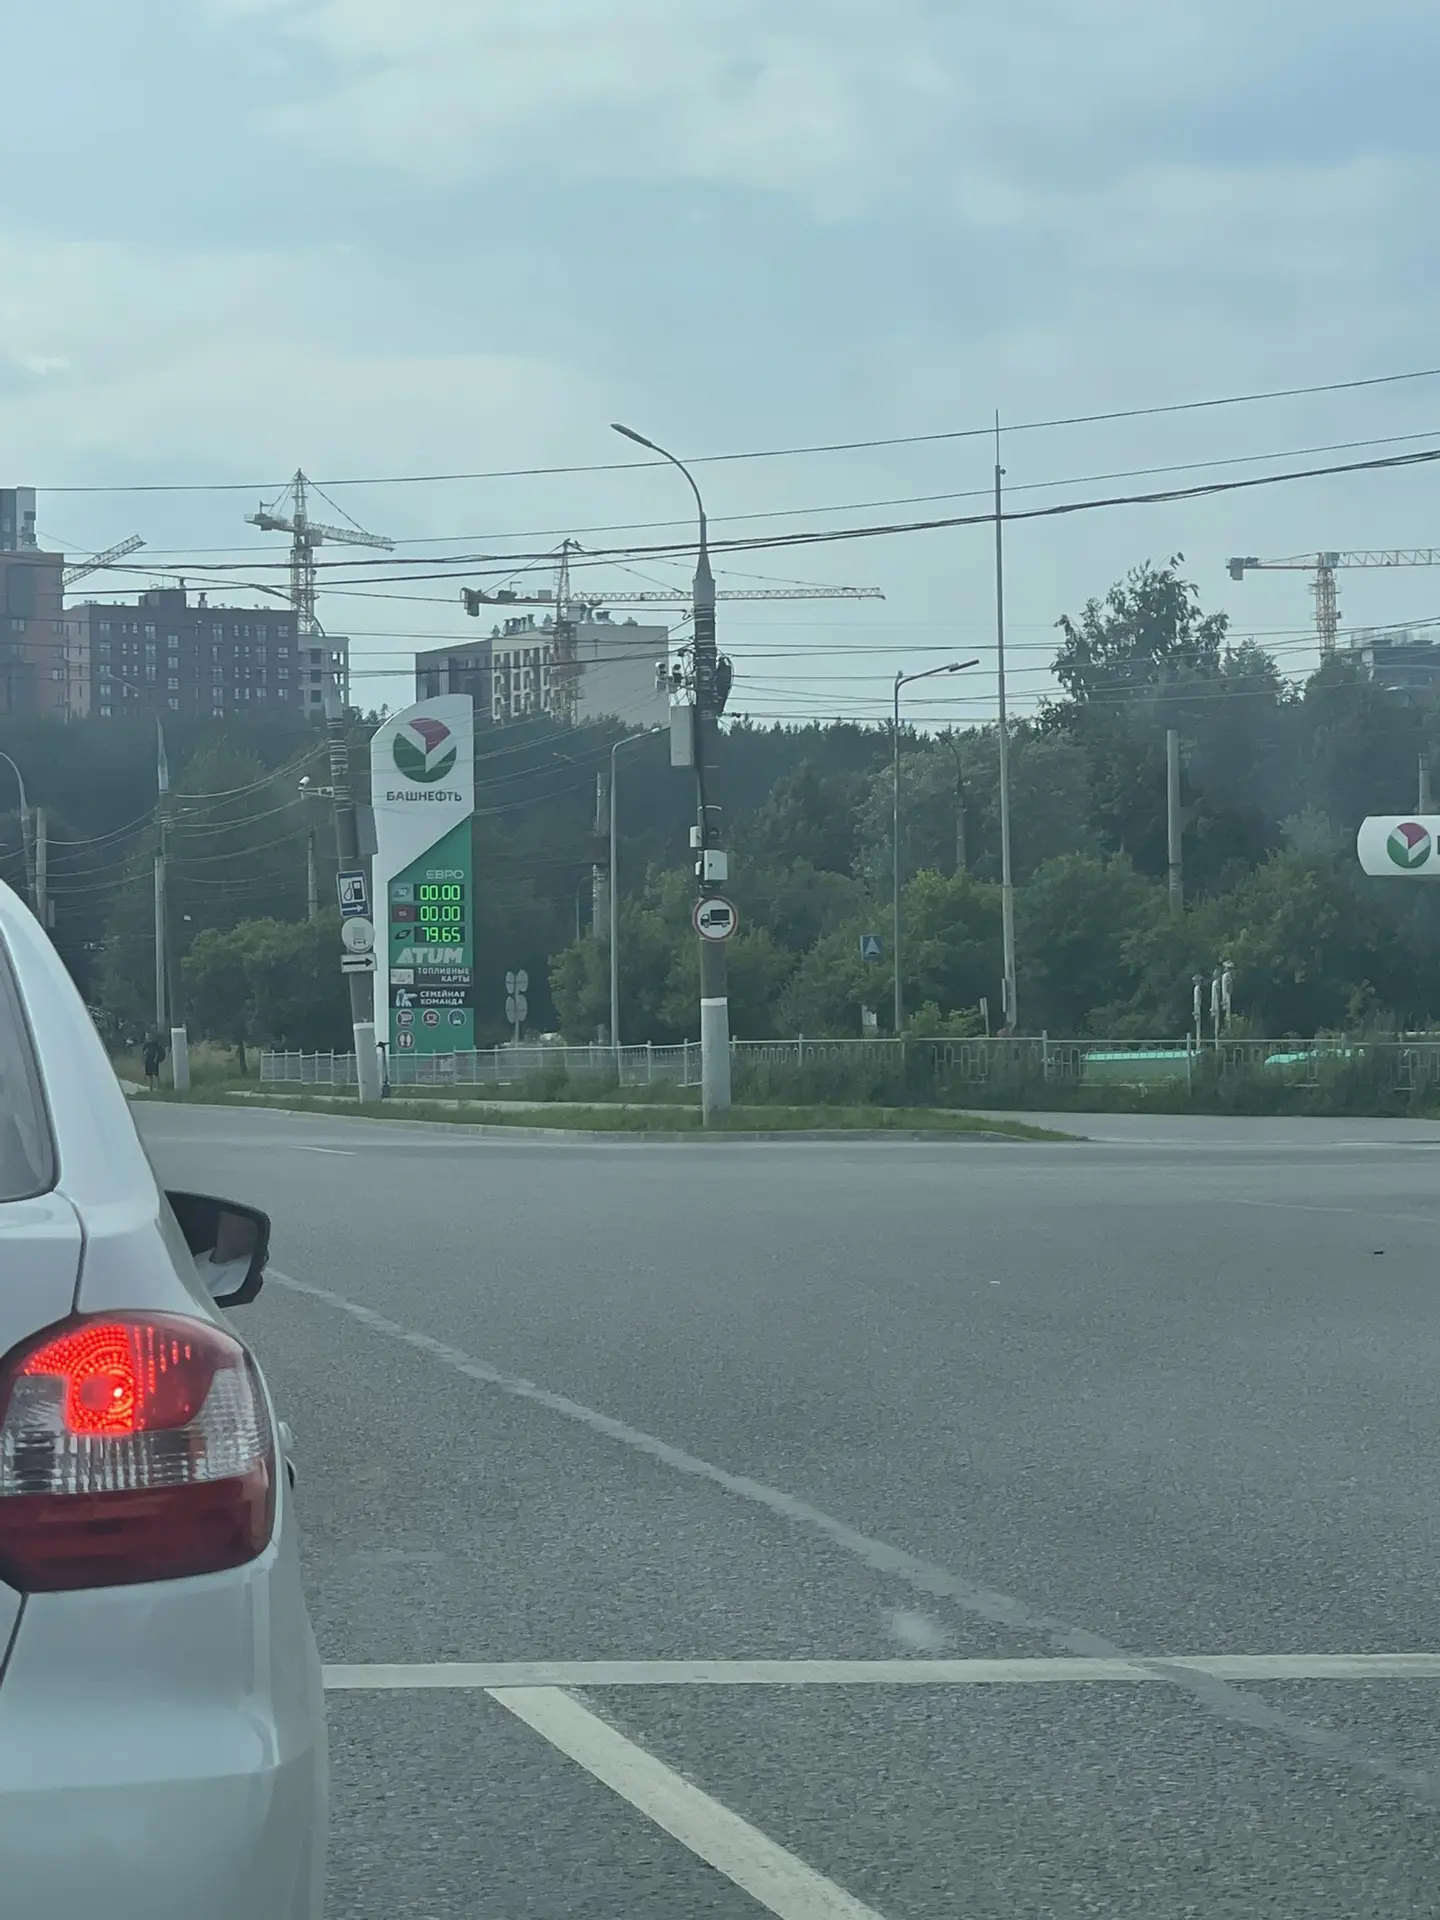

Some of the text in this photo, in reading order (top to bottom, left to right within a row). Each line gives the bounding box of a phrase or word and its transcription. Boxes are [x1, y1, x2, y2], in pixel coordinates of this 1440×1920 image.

[386, 791, 462, 802] БАШНЕФТЬ
[426, 870, 464, 879] ЕВРО
[420, 885, 460, 900] 00.00
[420, 906, 460, 921] 00.00
[421, 927, 460, 942] 79.65
[396, 948, 463, 964] ATUM
[420, 990, 465, 998] СЕМЕЙНАЯ
